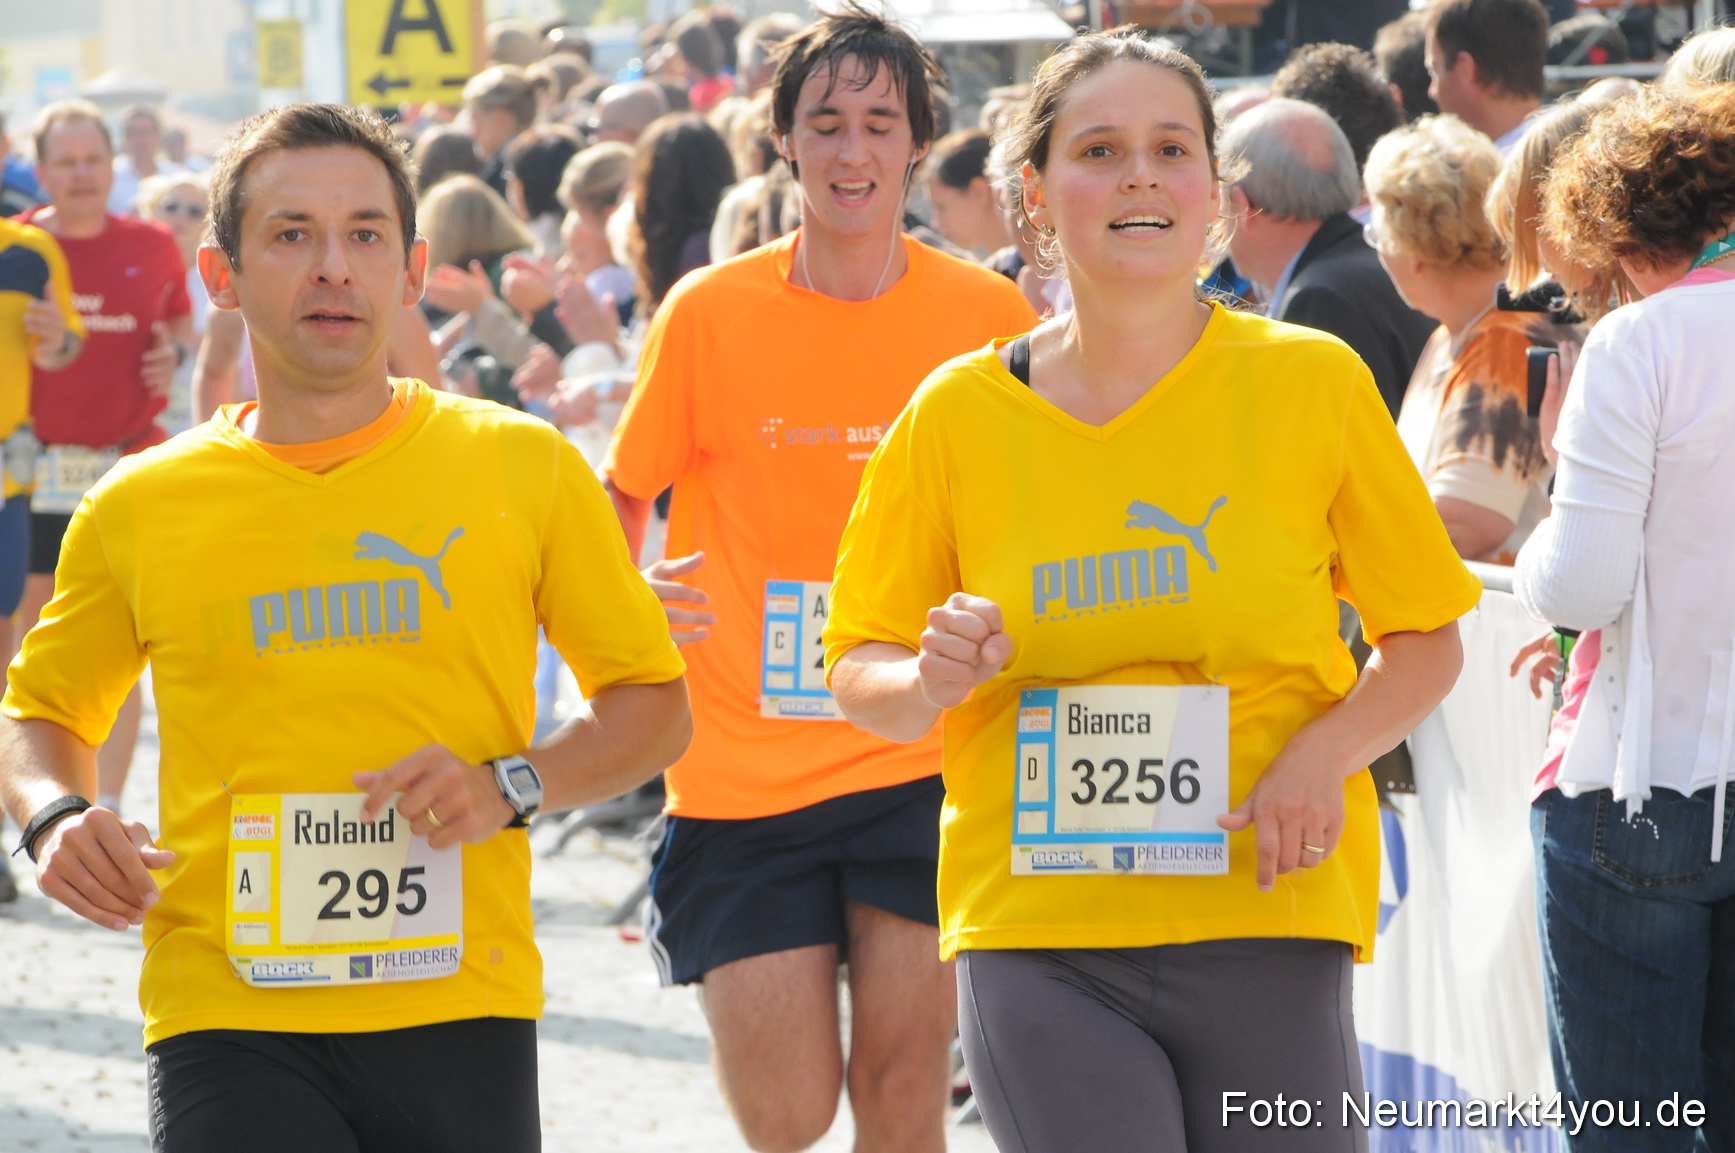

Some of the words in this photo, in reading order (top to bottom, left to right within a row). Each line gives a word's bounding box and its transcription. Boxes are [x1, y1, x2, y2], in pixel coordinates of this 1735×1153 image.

[381, 0, 453, 55] A
[785, 422, 841, 443] stark
[1033, 545, 1189, 615] PUMA
[249, 578, 421, 648] PUMA
[813, 595, 828, 617] A
[775, 631, 785, 649] C
[1068, 703, 1151, 736] Bianca
[1028, 758, 1037, 780] D
[1071, 758, 1201, 805] 3256
[294, 808, 395, 846] Roland
[1032, 850, 1084, 864] BOCK
[1137, 845, 1224, 861] PFLEIDERER
[238, 868, 252, 894] A
[317, 865, 427, 920] 295
[252, 961, 315, 976] BOCK
[376, 948, 458, 968] PFLEIDERER
